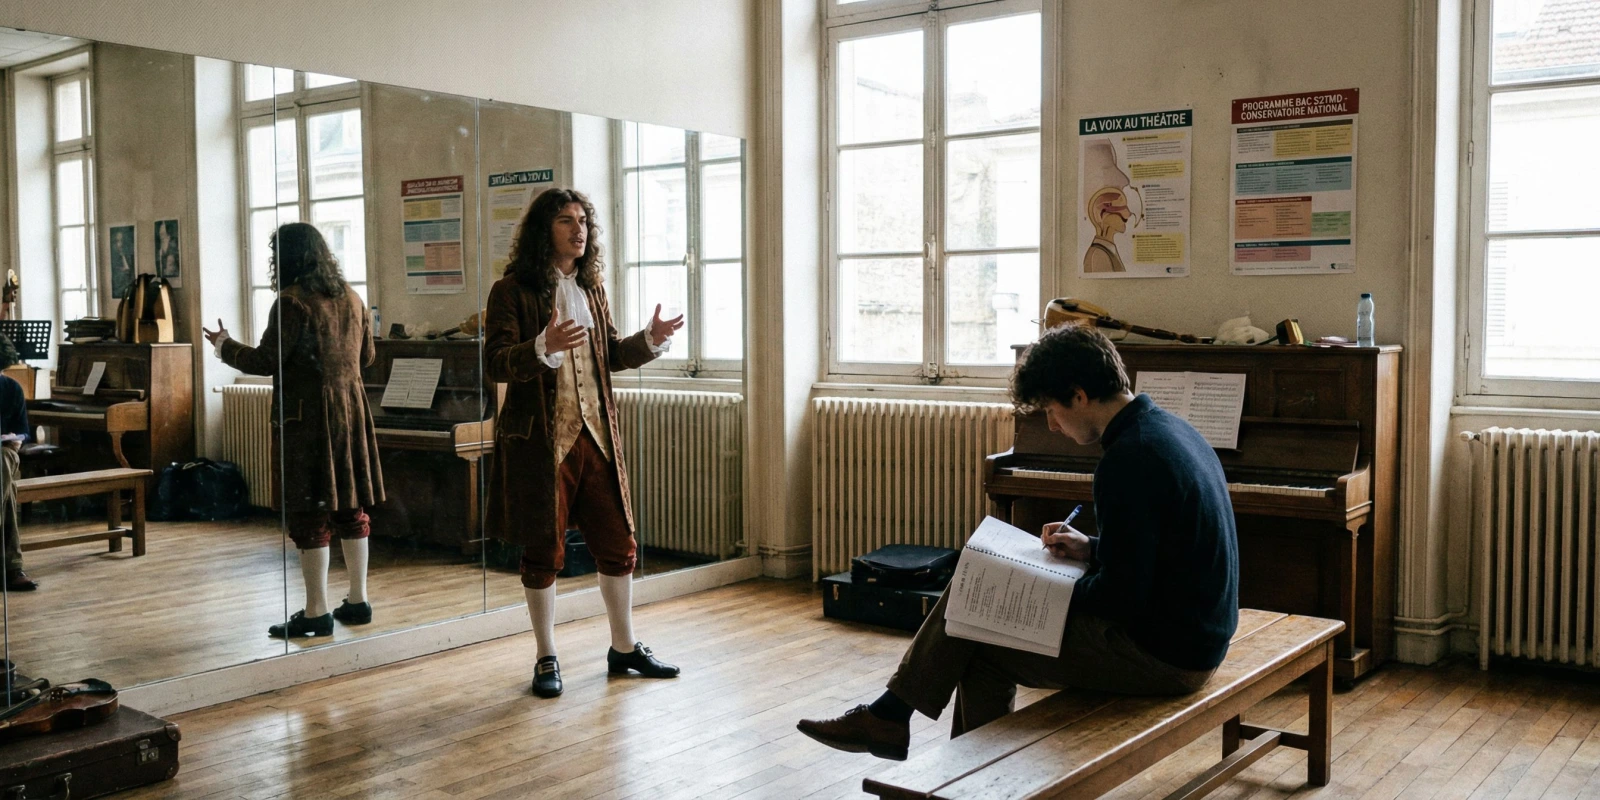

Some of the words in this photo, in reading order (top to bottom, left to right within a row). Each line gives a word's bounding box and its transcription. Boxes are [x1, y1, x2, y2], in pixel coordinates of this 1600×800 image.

[1295, 96, 1313, 107] BAC
[1313, 94, 1343, 105] S2TMD
[1241, 106, 1306, 120] CONSERVATOIRE
[1307, 102, 1348, 115] NATIONAL
[1085, 121, 1098, 132] LA
[1099, 118, 1122, 131] VOIX
[1124, 117, 1138, 129] AU
[1140, 112, 1186, 128] THÉÂTRE
